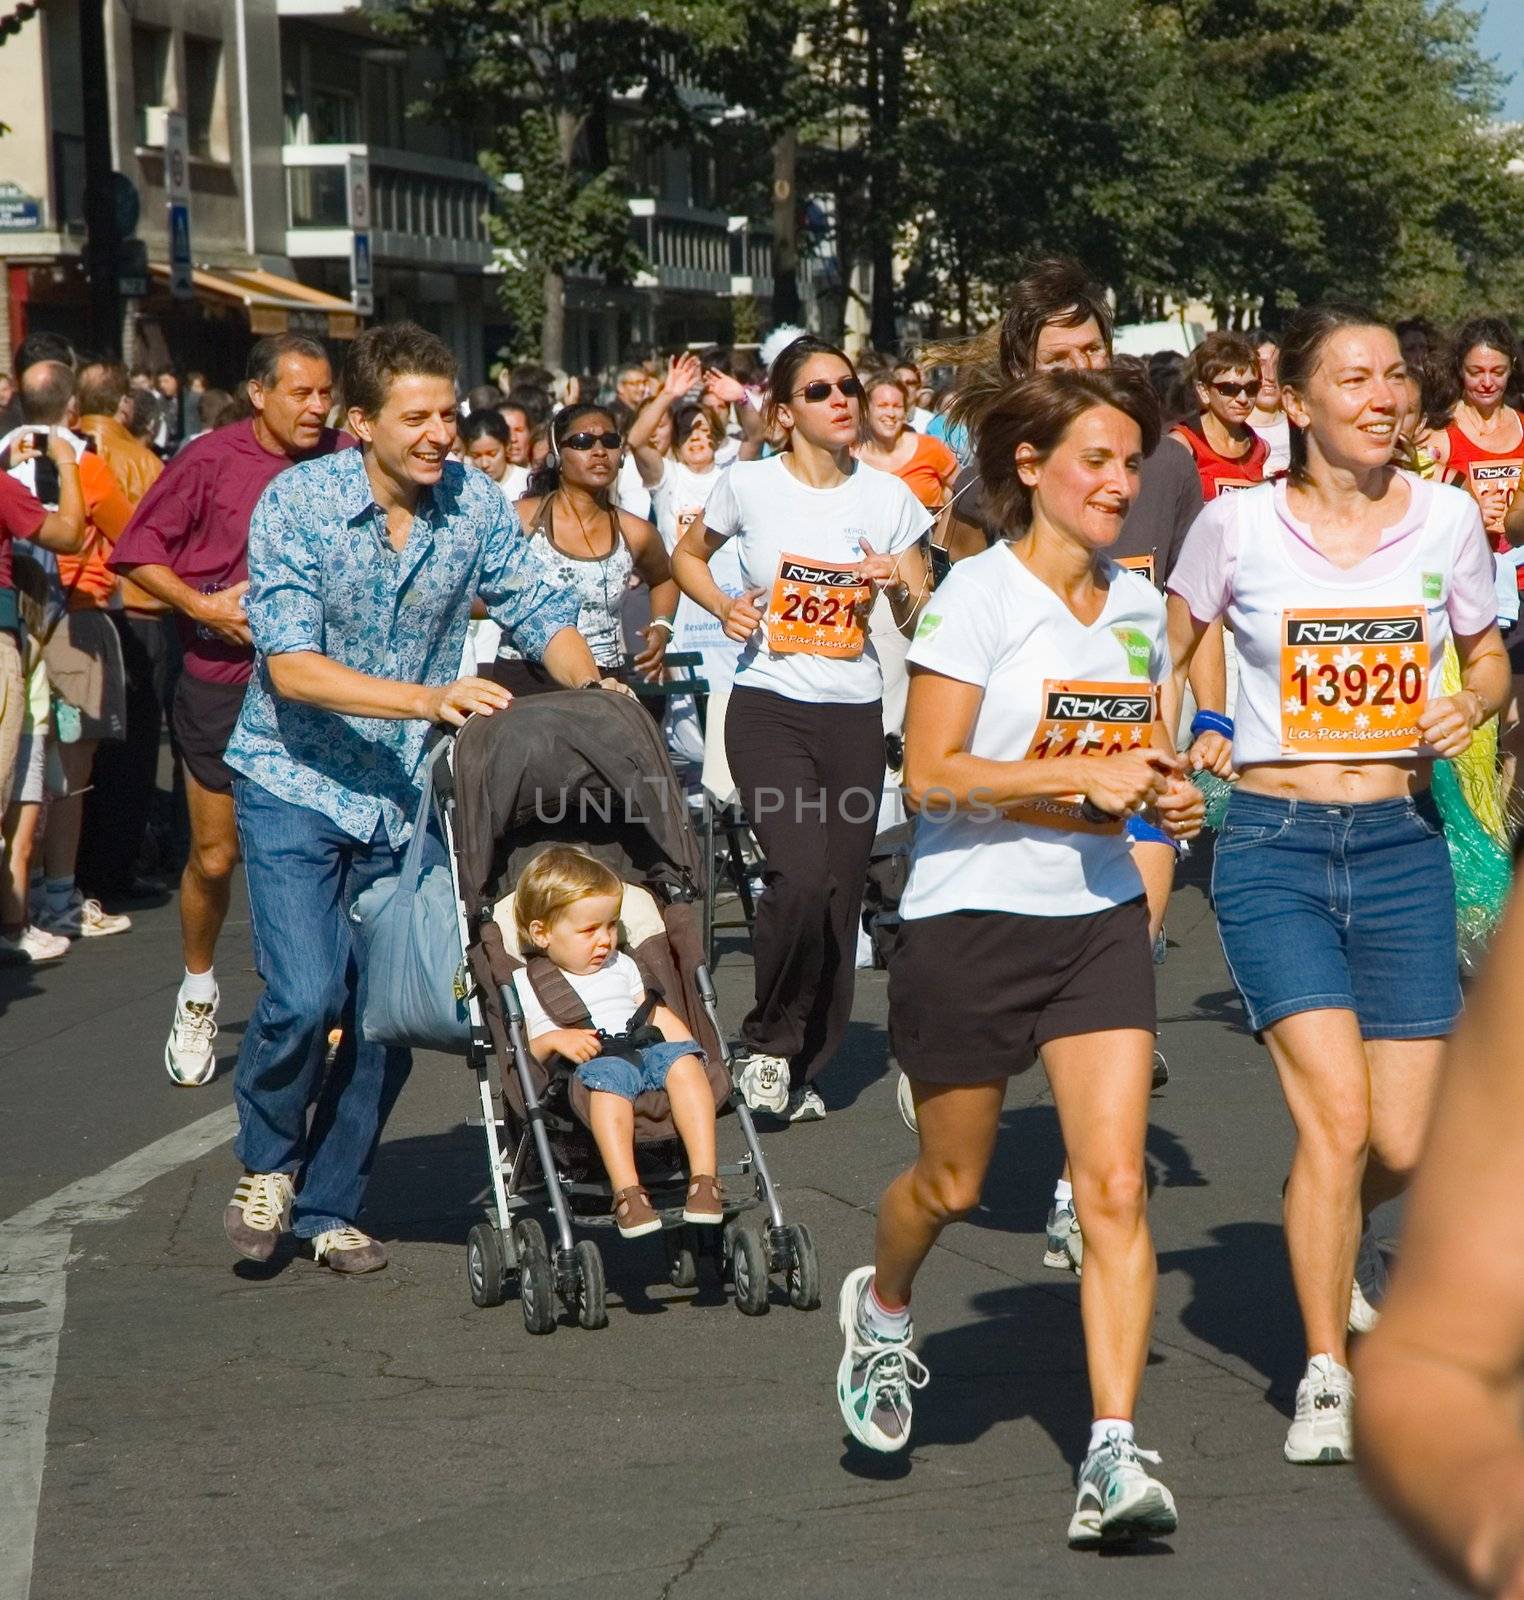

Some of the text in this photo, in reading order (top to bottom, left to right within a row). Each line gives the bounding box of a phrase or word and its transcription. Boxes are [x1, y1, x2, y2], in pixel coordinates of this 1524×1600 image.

[780, 594, 857, 628] 2621
[1290, 662, 1422, 707] 13920
[1288, 725, 1418, 742] La Parisienne
